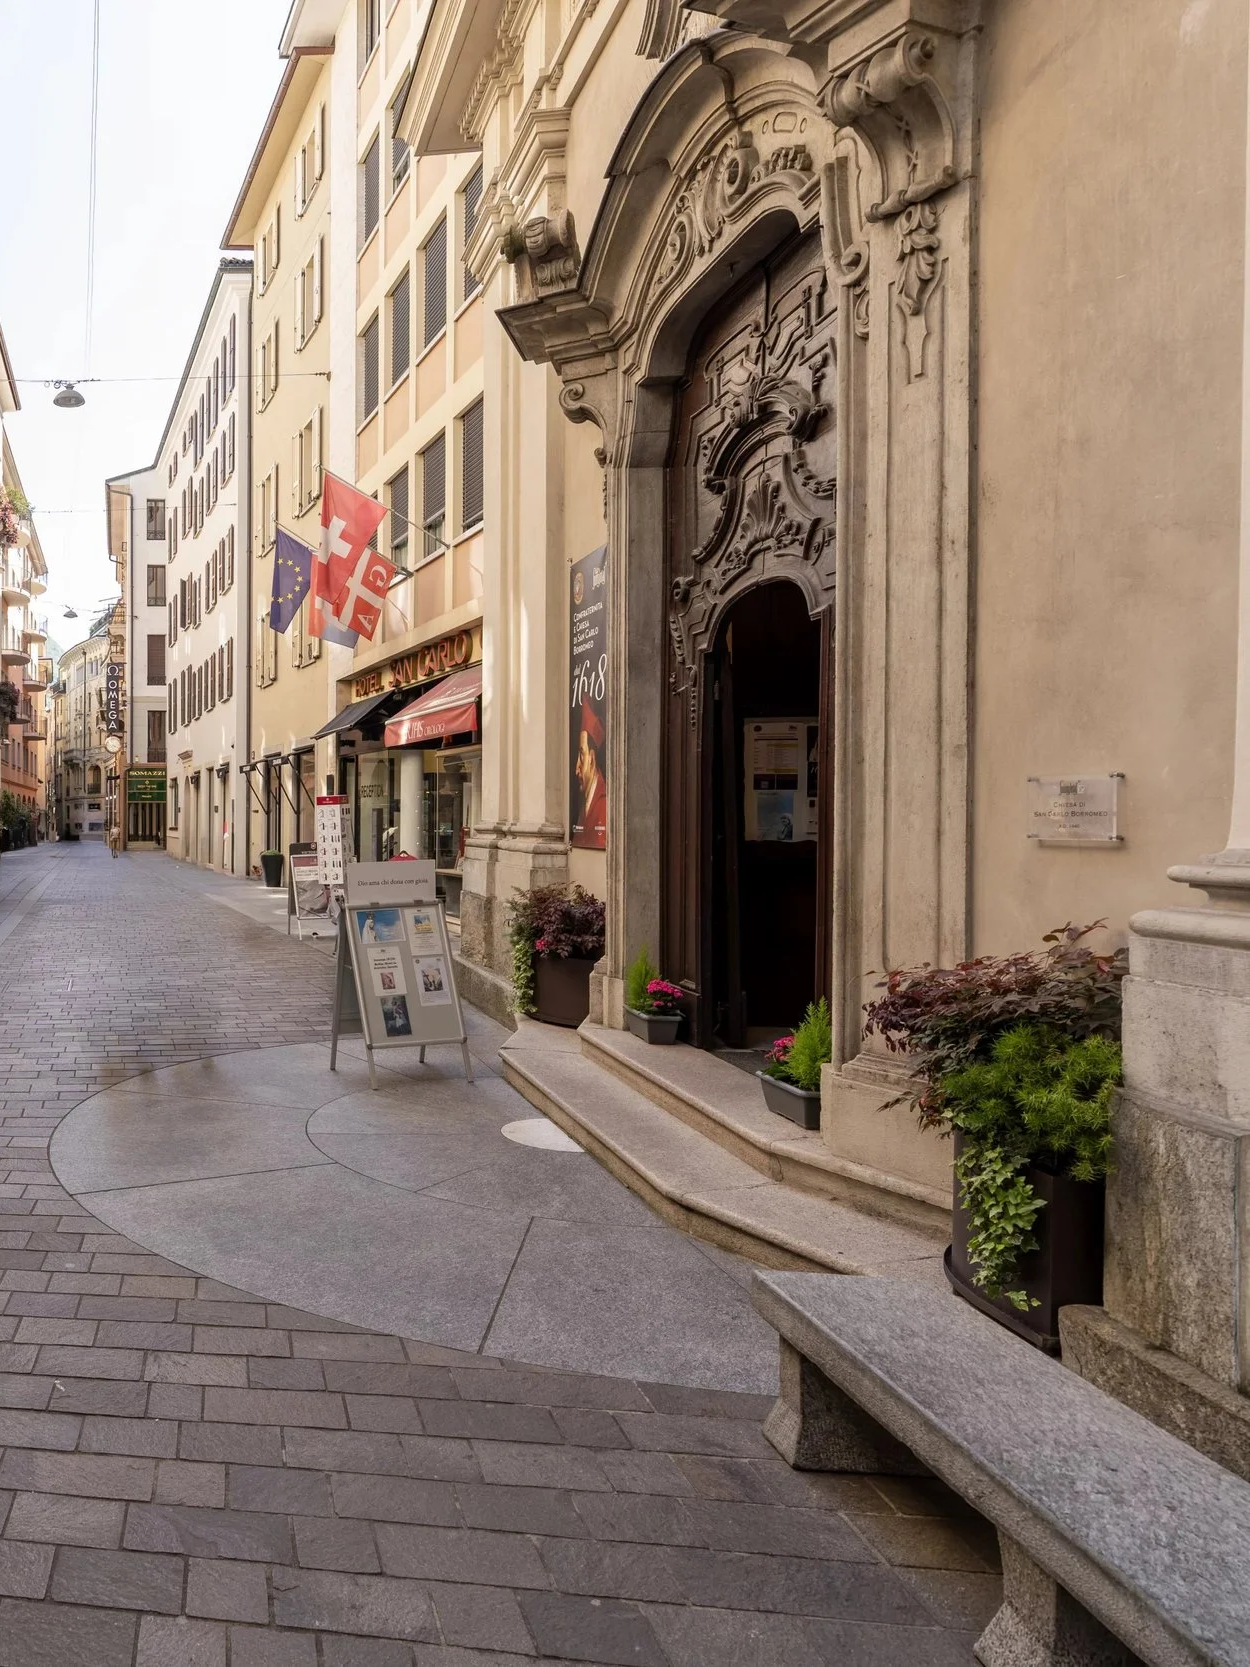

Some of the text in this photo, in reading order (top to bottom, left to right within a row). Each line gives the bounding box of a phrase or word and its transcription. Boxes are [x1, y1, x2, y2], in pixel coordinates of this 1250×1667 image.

[576, 621, 590, 632] CHIESA
[577, 632, 585, 643] SAN
[585, 626, 599, 640] CARLO
[355, 672, 383, 698] HOTEL
[389, 656, 416, 688] SAN
[417, 629, 473, 677] CARLO
[573, 640, 594, 656] BORROMEO
[572, 653, 607, 708] 1618
[107, 680, 118, 730] OMEGA
